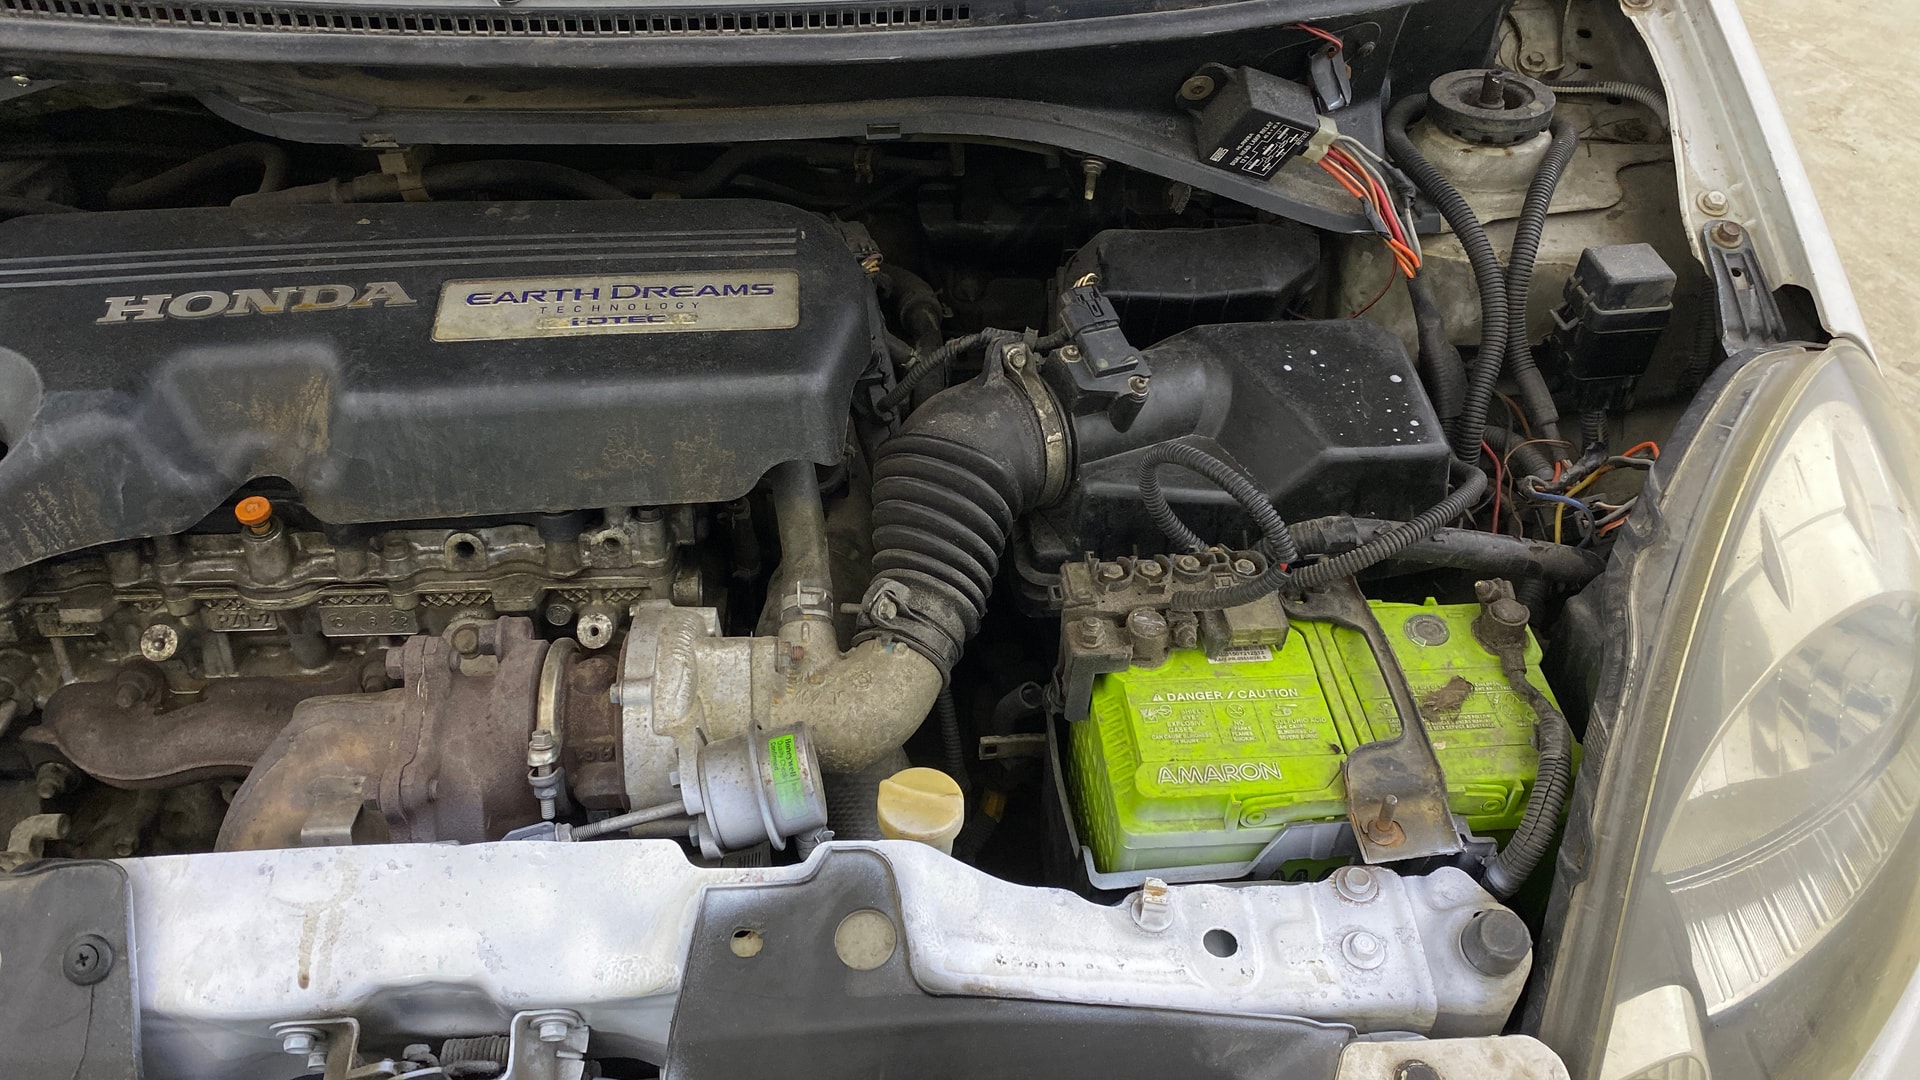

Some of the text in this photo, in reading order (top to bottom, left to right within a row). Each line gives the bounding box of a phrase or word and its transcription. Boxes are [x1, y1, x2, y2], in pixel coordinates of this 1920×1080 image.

[96, 281, 418, 325] HONDA
[466, 283, 775, 306] EARTH DREAMS
[540, 301, 700, 314] TECHNOLOGY
[1167, 690, 1222, 701] DANGER
[1237, 688, 1298, 699] CAUTION
[785, 738, 797, 777] Honeywell
[1158, 761, 1282, 785] AMARON
